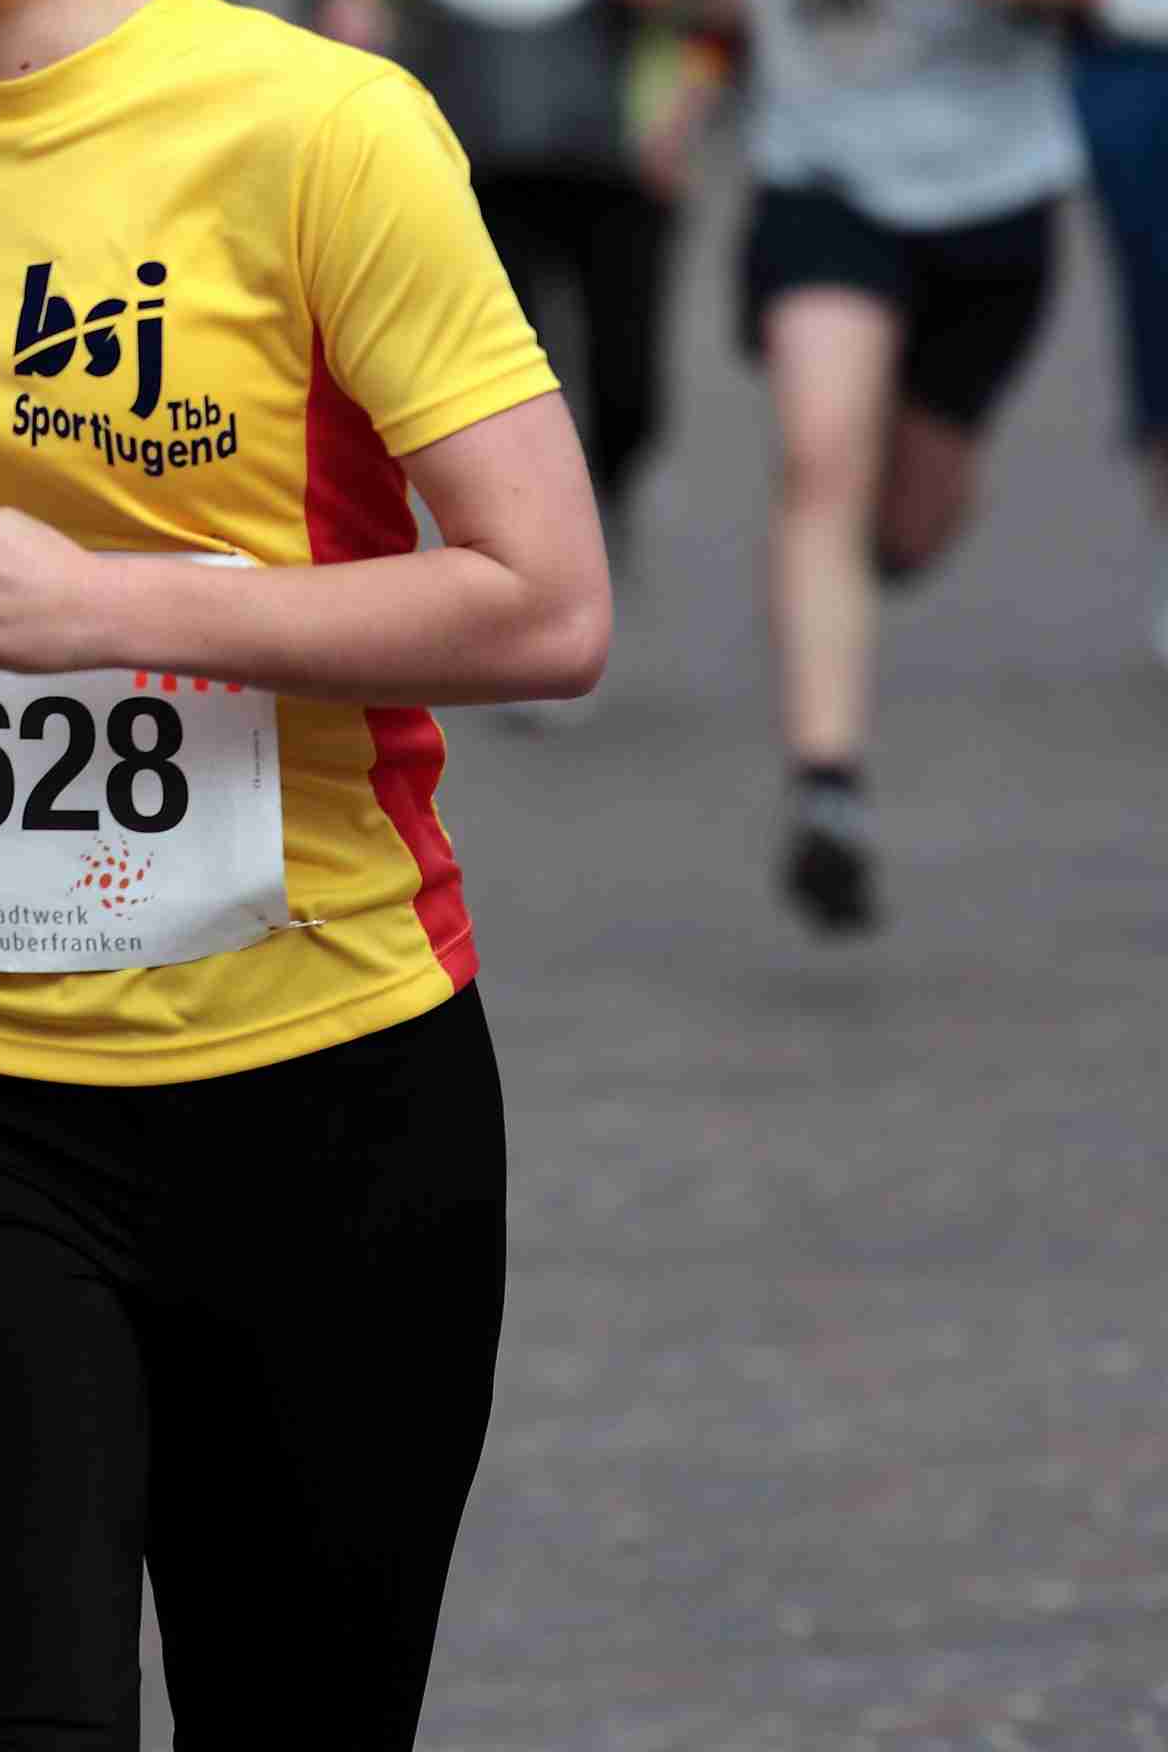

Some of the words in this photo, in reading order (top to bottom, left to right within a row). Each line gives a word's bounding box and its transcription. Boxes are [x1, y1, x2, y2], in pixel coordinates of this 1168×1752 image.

[13, 260, 168, 420] bsj
[12, 392, 238, 477] Sportjugend
[167, 395, 221, 432] Tbb
